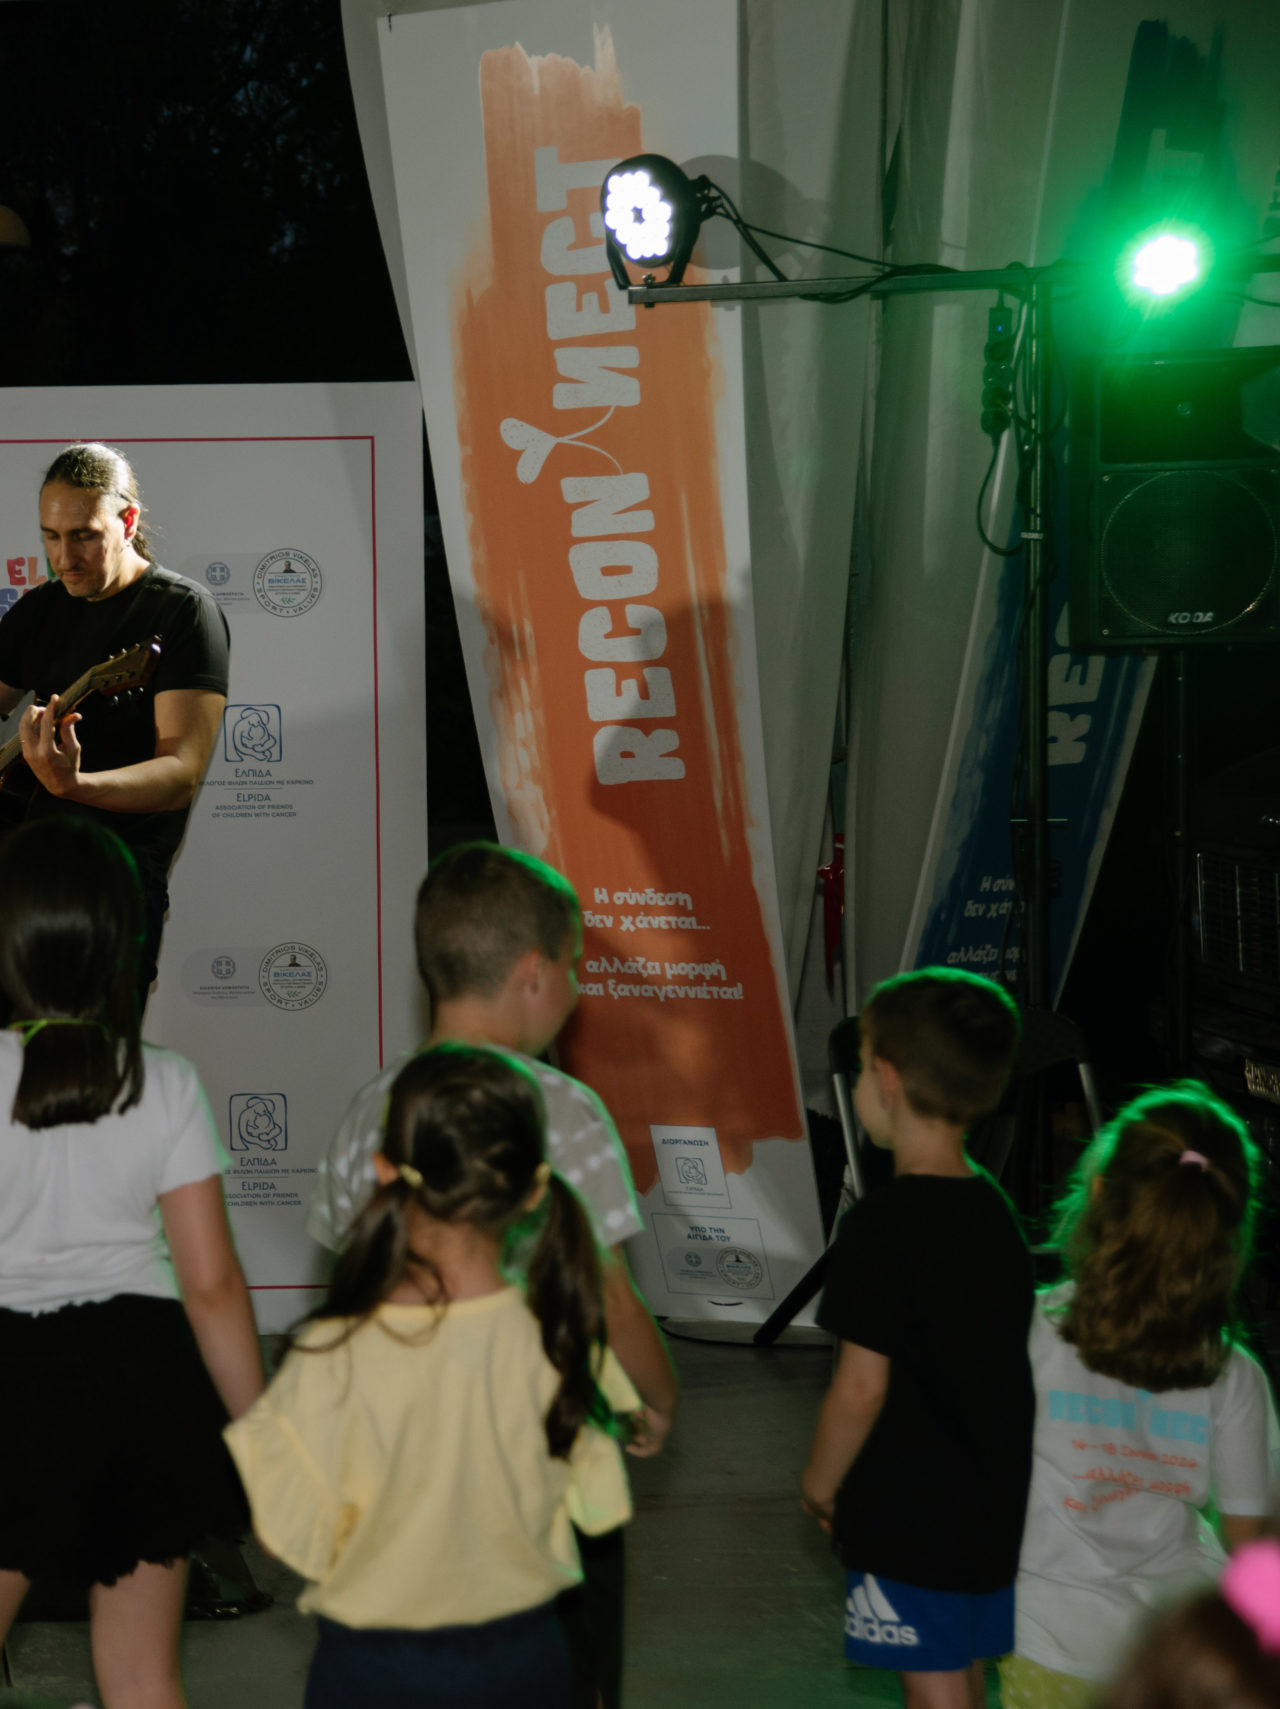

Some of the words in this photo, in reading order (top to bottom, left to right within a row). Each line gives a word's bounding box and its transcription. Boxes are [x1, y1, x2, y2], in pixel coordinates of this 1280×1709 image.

[234, 768, 272, 778] ΕΛΠΙΔΑ
[236, 793, 271, 803] ELPIDA
[613, 887, 693, 911] σύνδεση
[582, 910, 614, 928] δεν
[585, 956, 661, 978] αλλάζει
[664, 959, 727, 980] μορφή
[240, 1157, 277, 1167] ΕΛΠΙΔΑ
[241, 1181, 277, 1191] ELPIDA
